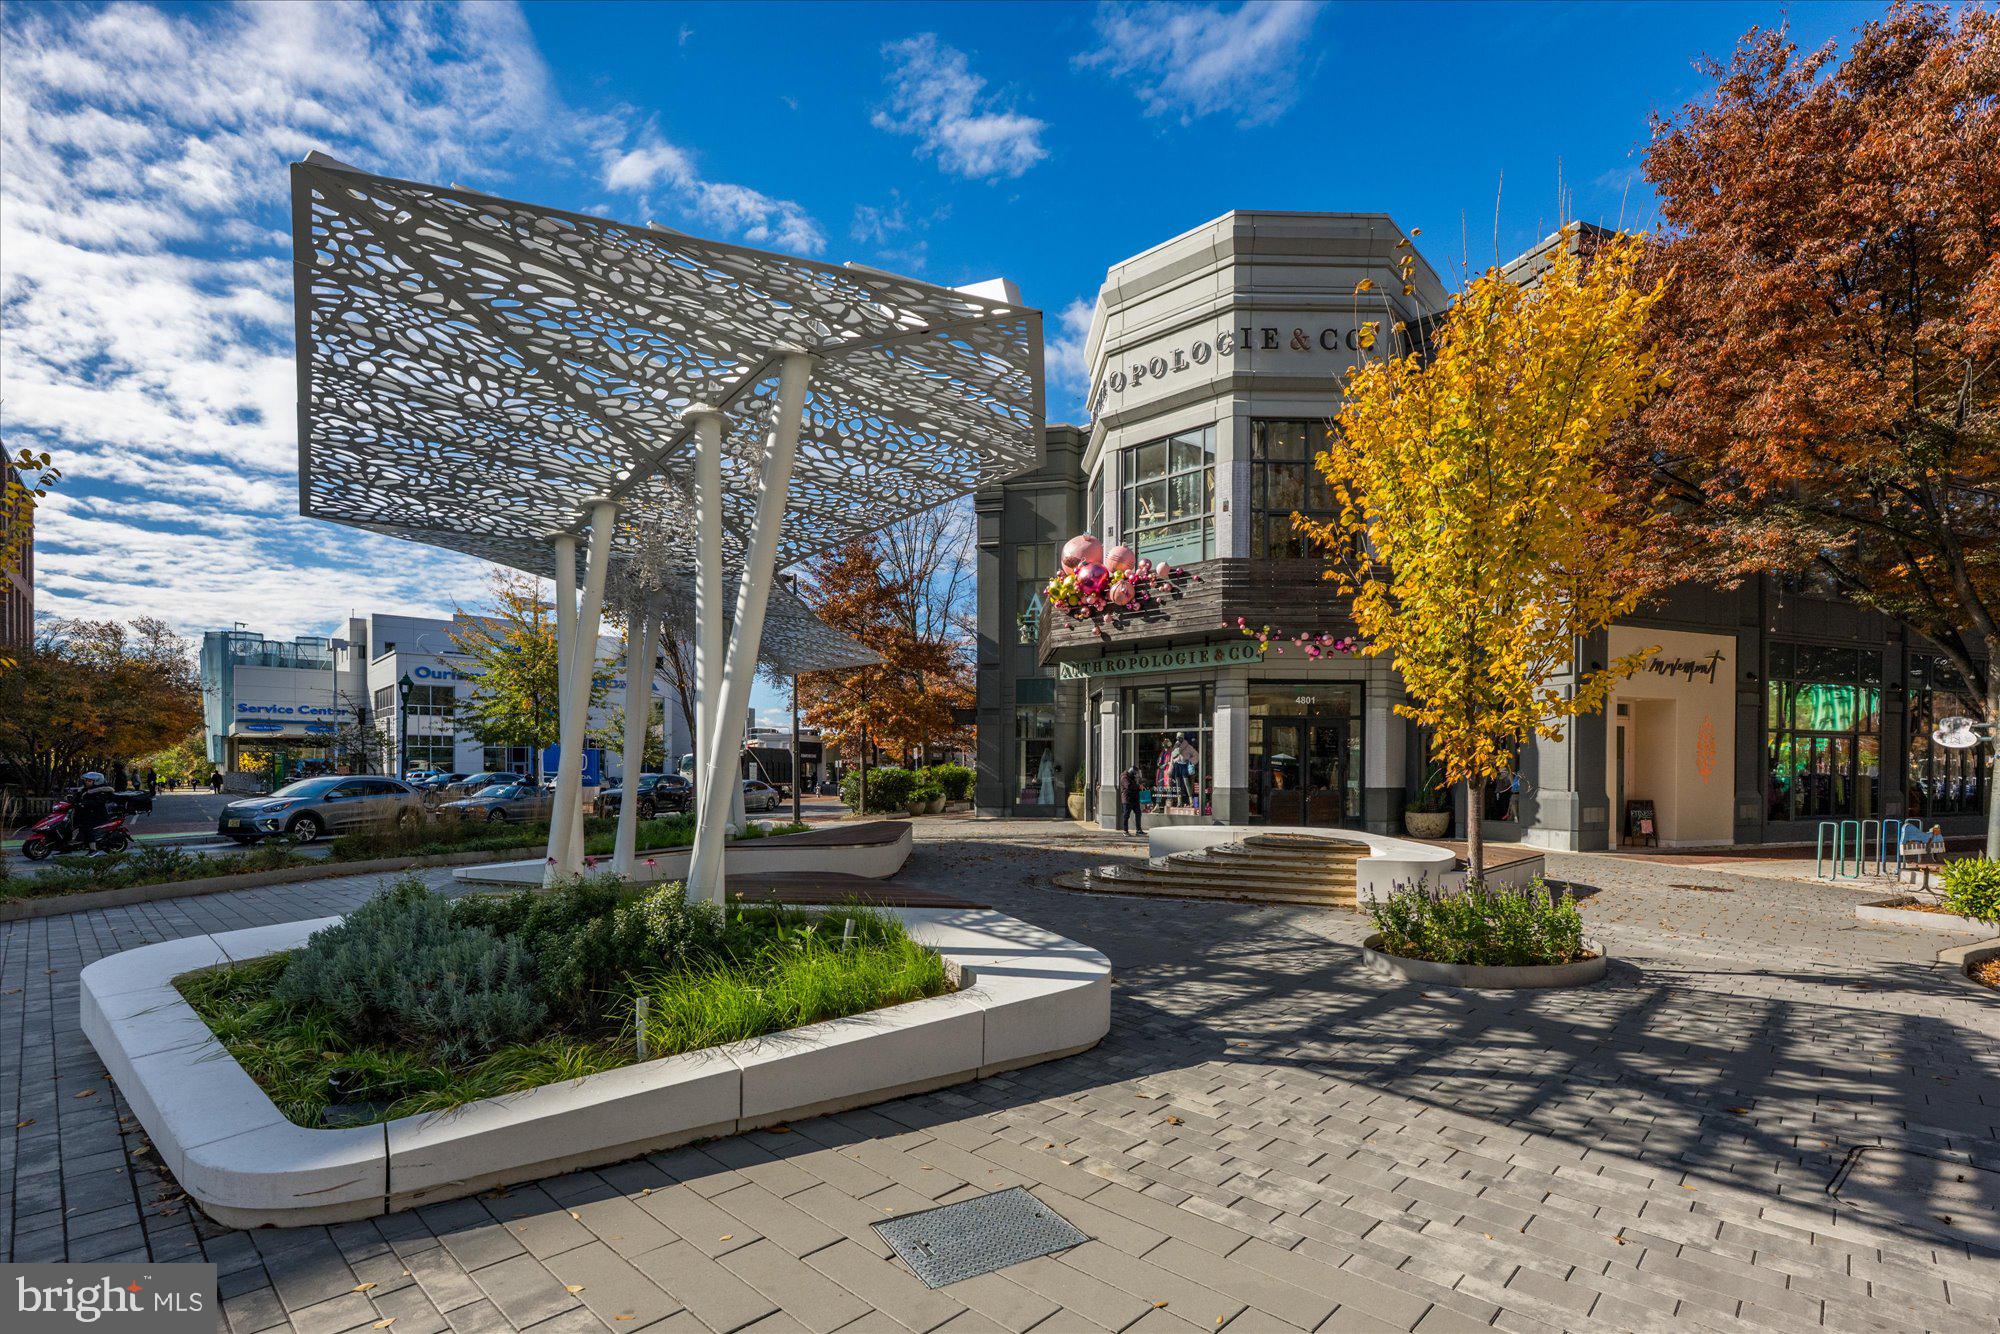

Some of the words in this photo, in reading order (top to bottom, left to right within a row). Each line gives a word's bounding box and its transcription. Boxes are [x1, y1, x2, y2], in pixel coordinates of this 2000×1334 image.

[1289, 327, 1311, 351] &
[1061, 650, 1209, 679] ANTHROPOLOGIE
[1295, 696, 1316, 704] 4801
[237, 703, 294, 714] Service
[297, 705, 349, 716] Center
